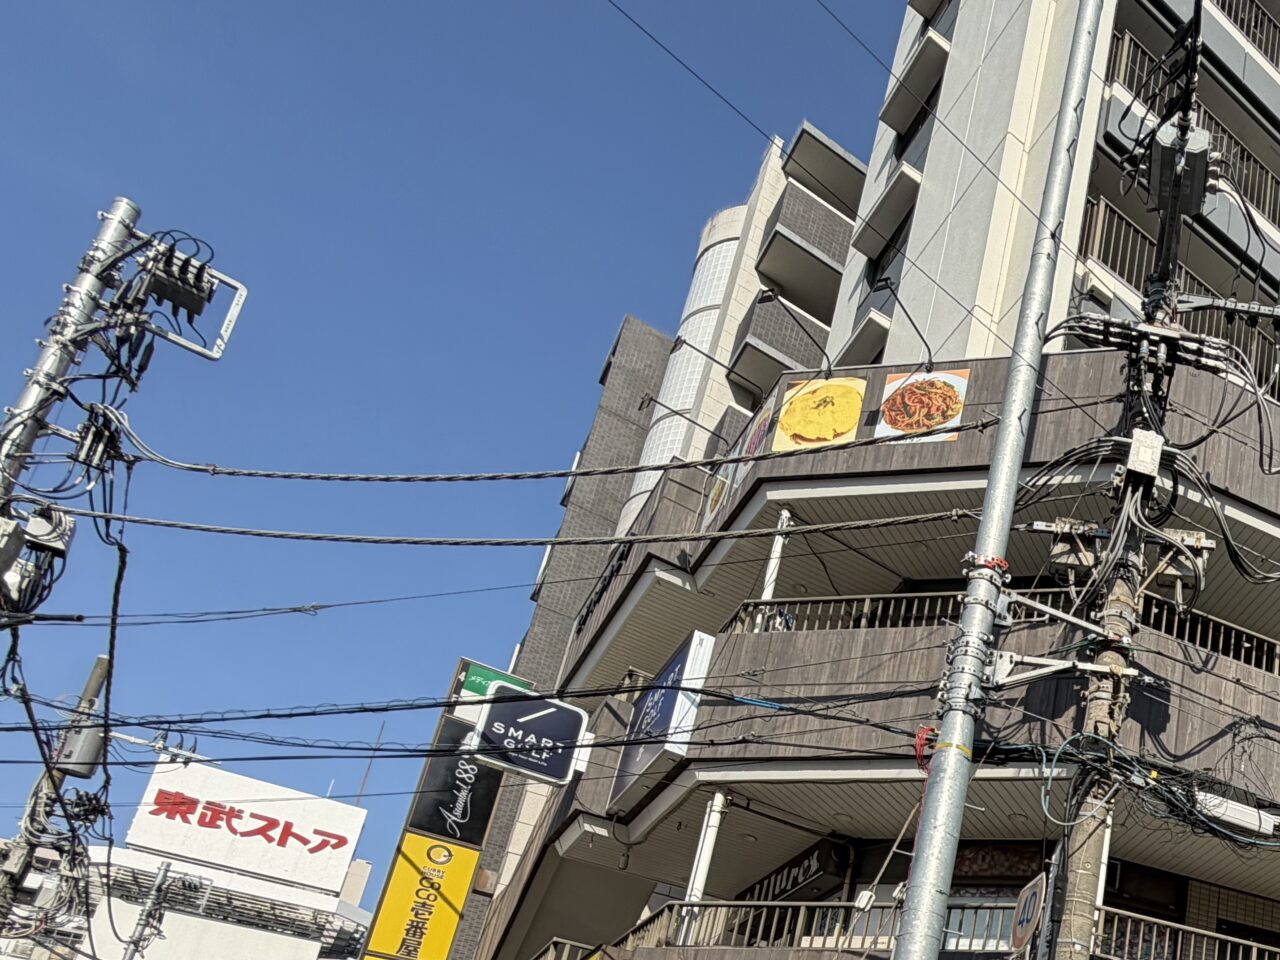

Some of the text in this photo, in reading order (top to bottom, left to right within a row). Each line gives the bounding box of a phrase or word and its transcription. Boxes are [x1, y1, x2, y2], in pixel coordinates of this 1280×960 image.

[491, 721, 566, 755] SMART
[148, 788, 349, 854] 東武ストア
[1018, 891, 1037, 928] 40
